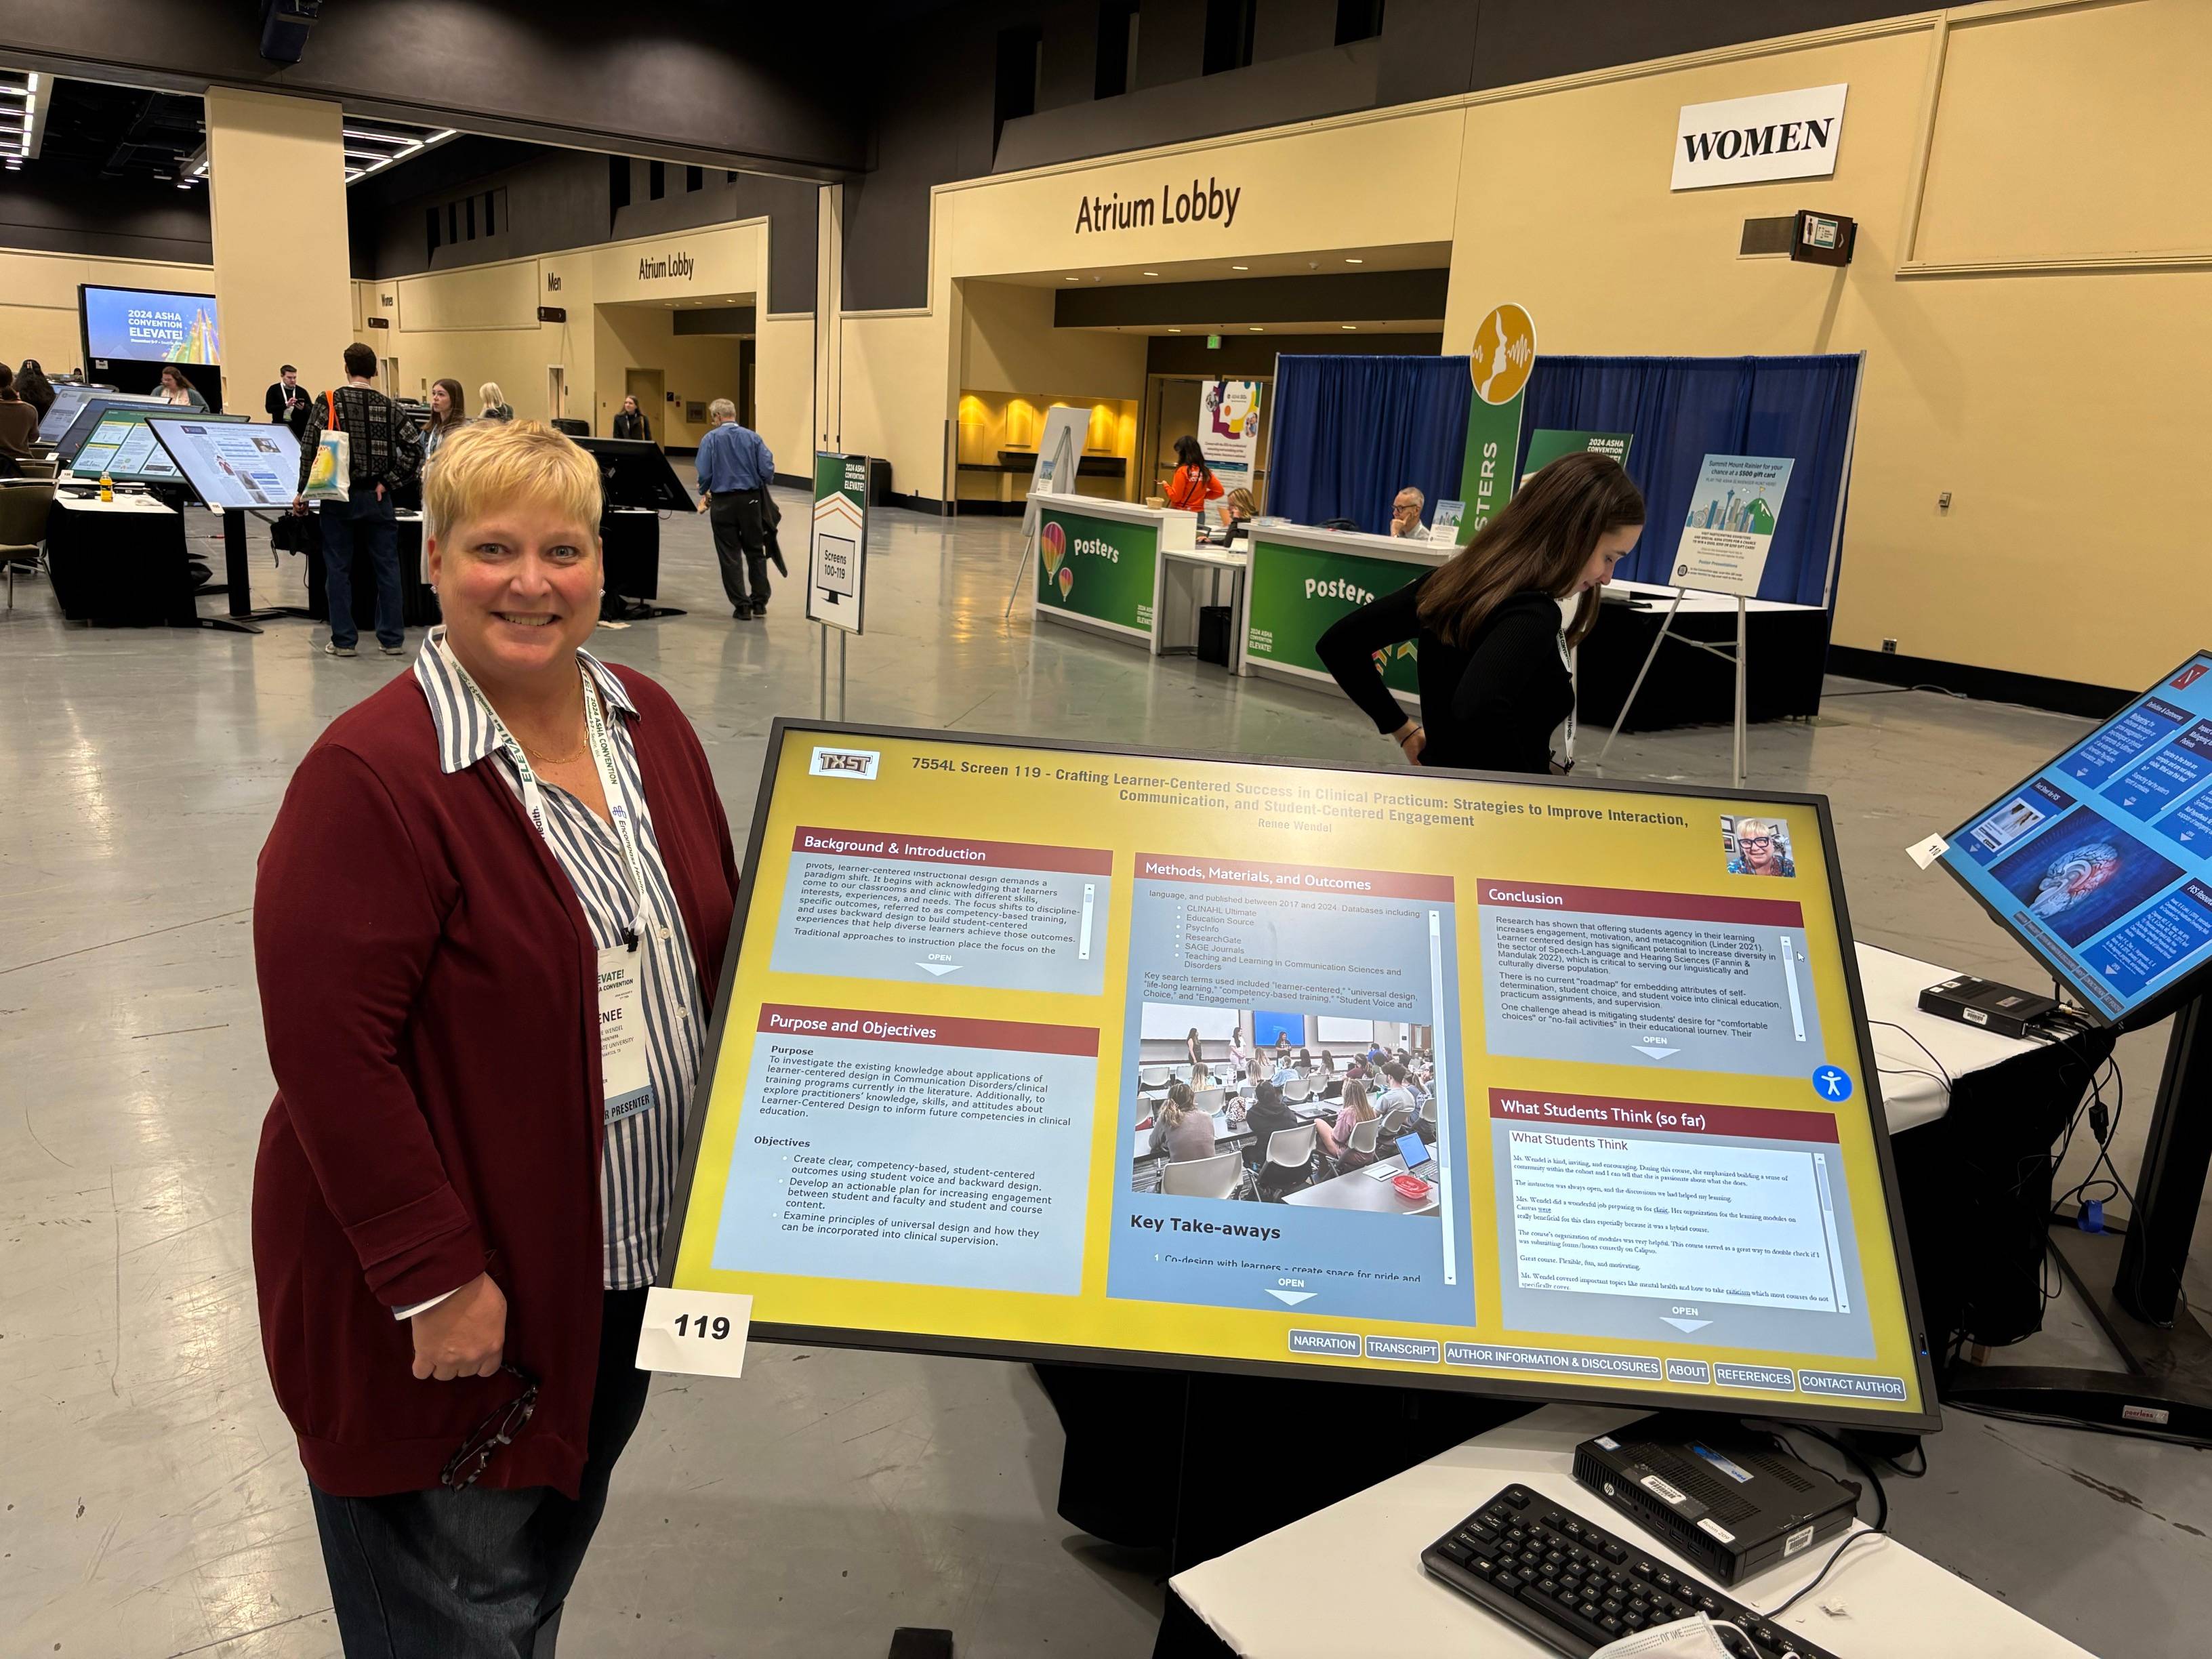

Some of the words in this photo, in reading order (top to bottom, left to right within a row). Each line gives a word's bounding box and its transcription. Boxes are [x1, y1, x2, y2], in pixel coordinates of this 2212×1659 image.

[1683, 118, 1835, 163] WOMEN
[1076, 192, 1154, 234] Atrium
[1162, 177, 1241, 228] Lobby
[639, 257, 666, 280] Atrium
[668, 251, 694, 281] Lobby
[548, 272, 561, 291] Men
[128, 310, 152, 319] 2024
[155, 312, 182, 321] ASHA
[128, 319, 182, 329] CONVENTION
[129, 327, 183, 340] ELEVATE!
[1587, 446, 1623, 454] CONVENTION
[1589, 438, 1605, 447] 2024
[1605, 439, 1624, 447] ASHA
[844, 472, 865, 480] CONVENTION
[845, 464, 855, 472] 2024
[855, 464, 865, 473] ASHA
[844, 480, 865, 492] ELEVATE!
[1474, 442, 1497, 531] STERS
[824, 550, 847, 565] Screens
[1073, 538, 1120, 563] Posters
[824, 565, 846, 579] 100-119
[1305, 578, 1375, 605] Posters
[1261, 630, 1273, 638] ASHA
[1249, 640, 1272, 652] ELEVATE!
[590, 697, 598, 716] 2024
[594, 716, 605, 735] ASHA
[599, 735, 618, 785] CONVENTION
[819, 752, 872, 775] TXST
[912, 757, 956, 772] 7554L
[960, 761, 1008, 776] Screen
[1015, 765, 1041, 778] 119
[1056, 769, 1109, 786] Crafting
[1113, 773, 1231, 792] Learner-Centered
[1235, 779, 1293, 797] Success
[1298, 785, 1311, 799] in
[1315, 787, 1368, 803] Clinical
[1374, 792, 1448, 808] Practicum:
[1453, 798, 1524, 815] Strategies
[1528, 803, 1542, 815] to
[1547, 804, 1603, 820] Improve
[1607, 808, 1688, 828] Interaction,
[1120, 789, 1229, 811] Communication,
[1234, 799, 1259, 811] and
[1264, 800, 1384, 820] Student-Centered
[1389, 808, 1475, 827] Engagement
[1258, 818, 1291, 830] Renee
[1293, 821, 1332, 833] Wendel
[618, 819, 636, 865] Encompass
[804, 836, 884, 853] Background
[888, 842, 899, 854] &
[905, 843, 986, 861] Introduction
[1145, 861, 1206, 880] Methods,
[1208, 867, 1273, 885] Materials,
[1275, 873, 1300, 885] and
[1305, 874, 1372, 890] Outcomes
[1488, 888, 1563, 905] Conclusion
[1187, 904, 1223, 914] CLINAHL
[1225, 907, 1257, 918] Ultimate
[1186, 914, 1225, 924] Education
[1227, 917, 1255, 928] Source
[1185, 923, 1219, 935] PsycInfo
[1185, 933, 1242, 944] ResearchGate
[1184, 943, 1209, 951] SAGE
[1211, 944, 1245, 954] Journals
[928, 953, 952, 962] OPEN
[598, 969, 624, 984] EVATE!
[603, 979, 634, 991] CONVENTION
[598, 1008, 623, 1025] ENEE
[605, 1025, 623, 1036] WENDEL
[770, 1014, 827, 1031] Purpose
[831, 1020, 859, 1033] and
[862, 1021, 937, 1038] Objectives
[609, 1037, 634, 1048] UNIVERSITY
[1643, 1036, 1668, 1044] OPEN
[771, 1045, 814, 1057] Purpose
[769, 1055, 780, 1063] To
[783, 1056, 834, 1068] investigate
[837, 1060, 853, 1069] the
[855, 1062, 891, 1073] existing
[894, 1063, 944, 1077] knowledge
[946, 1068, 974, 1078] about
[976, 1071, 1031, 1082] applications
[1033, 1074, 1044, 1083] of
[611, 1094, 650, 1118] PRESENTER
[1500, 1099, 1540, 1115] What
[1543, 1103, 1608, 1120] Students
[1610, 1107, 1653, 1124] Think
[1656, 1111, 1677, 1128] (so
[1681, 1113, 1706, 1130] far)
[754, 1136, 811, 1147] Objectives
[1512, 1132, 1542, 1146] What
[1544, 1134, 1596, 1148] Students
[1597, 1138, 1629, 1151] Think
[1130, 1214, 1164, 1233] Key
[1170, 1217, 1281, 1242] Take-aways
[1277, 1277, 1305, 1288] OPEN
[1672, 1306, 1699, 1316] OPEN
[674, 1313, 730, 1340] 119
[1294, 1335, 1356, 1350] NARRATION
[1368, 1341, 1437, 1356] TRANSCRIPT
[1447, 1348, 1493, 1361] AUTHOR
[1495, 1351, 1569, 1366] INFORMATION
[1572, 1357, 1580, 1367] &
[1581, 1357, 1659, 1373] DISCLOSURES
[1668, 1364, 1706, 1377] ABOUT
[1717, 1368, 1791, 1385] REFERENCES
[1802, 1376, 1853, 1390] CONTACT
[1855, 1380, 1902, 1394] AUTHOR
[1604, 1483, 1614, 1496] hp
[1702, 1520, 1721, 1535] Room
[1718, 1530, 1731, 1541] 209
